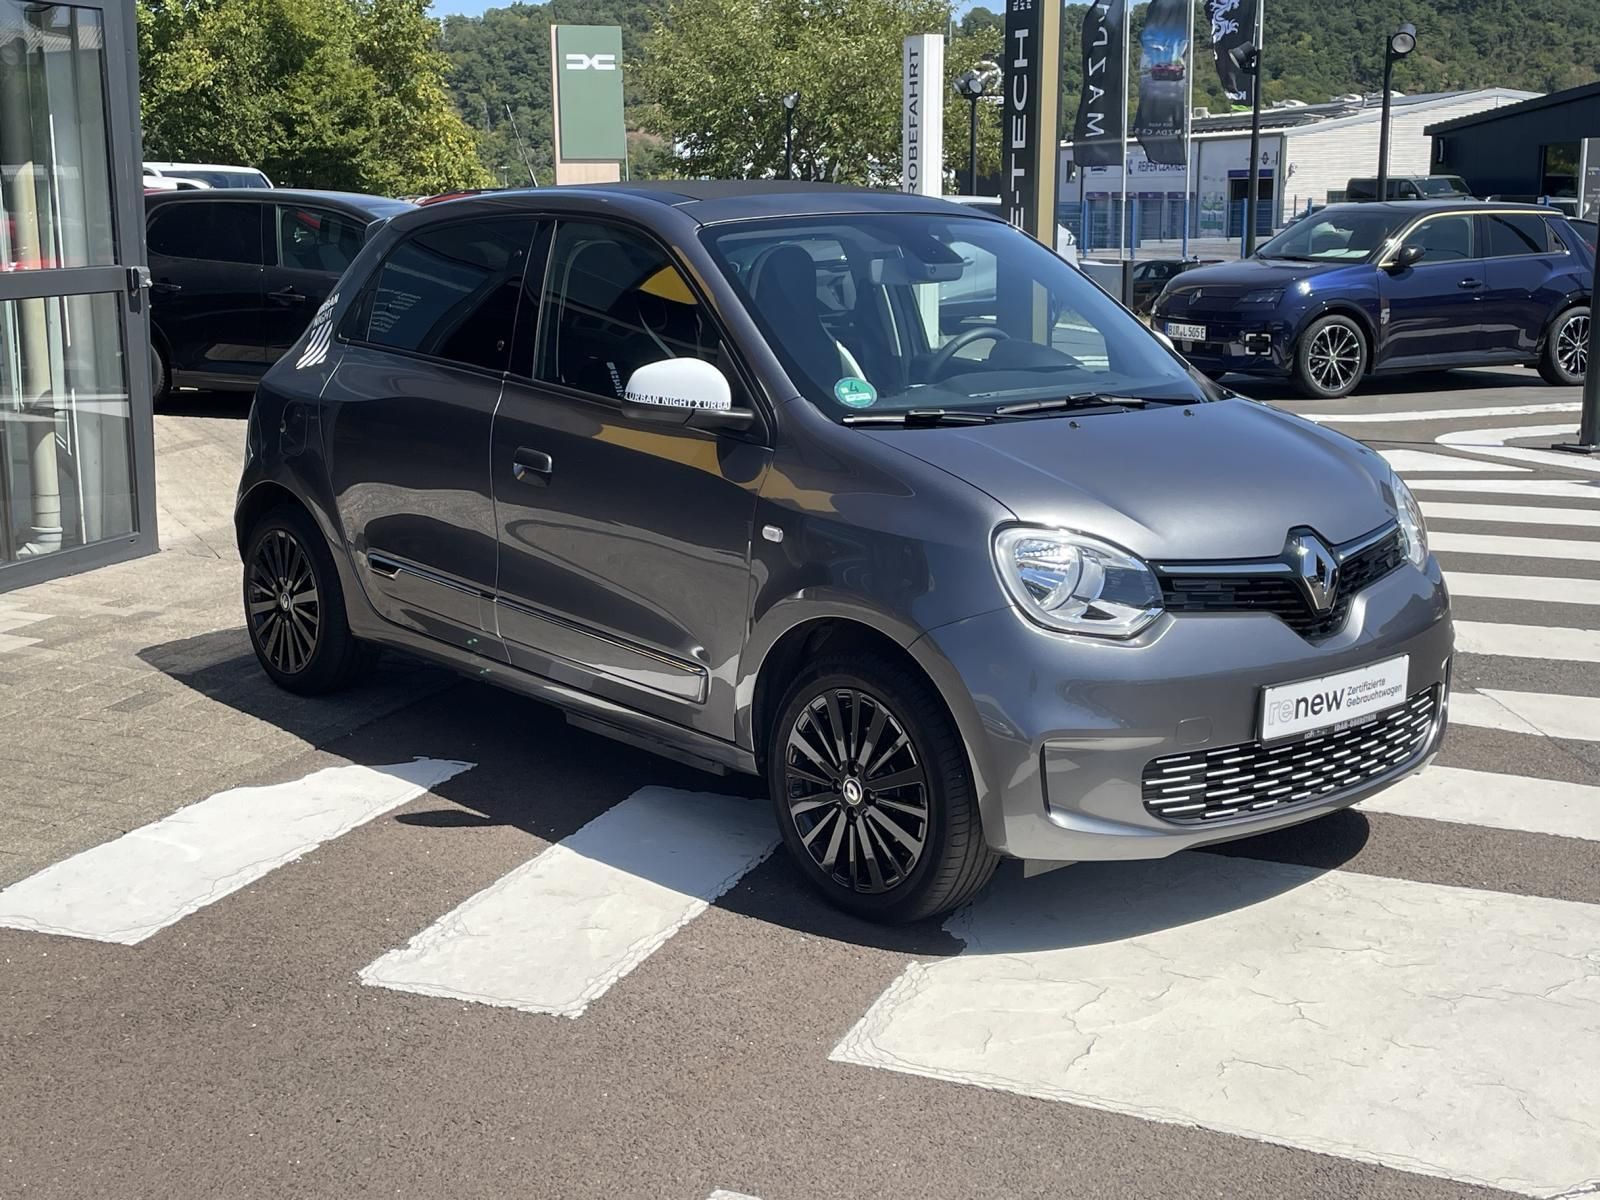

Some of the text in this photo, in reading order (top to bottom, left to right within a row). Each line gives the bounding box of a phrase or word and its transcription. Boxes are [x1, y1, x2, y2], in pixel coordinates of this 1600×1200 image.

[1010, 29, 1029, 230] E-TECH
[850, 382, 859, 392] 4
[628, 391, 658, 404] URBAN
[661, 395, 691, 407] NIGHT
[1346, 684, 1403, 708] Gebrauchtwagen
[1347, 678, 1387, 696] Zertifizierte
[1268, 688, 1346, 726] renew
